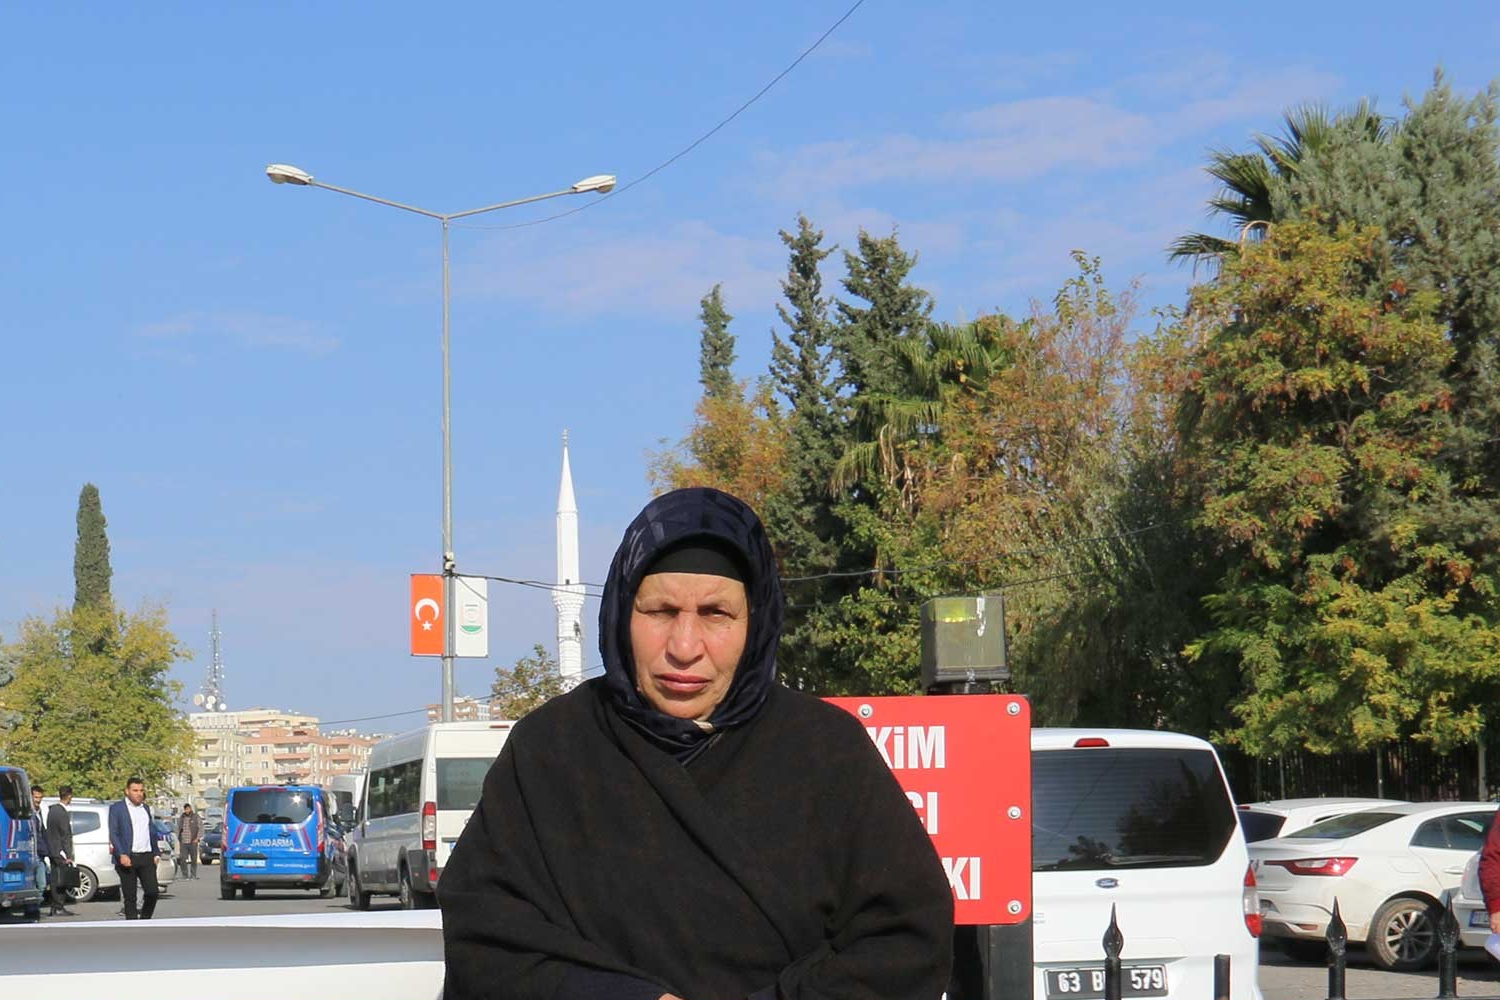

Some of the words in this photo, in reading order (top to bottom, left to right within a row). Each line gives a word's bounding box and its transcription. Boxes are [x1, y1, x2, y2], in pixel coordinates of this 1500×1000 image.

[250, 838, 294, 848] JANDARMA
[1057, 972, 1081, 993] 63
[1130, 968, 1164, 990] 579
